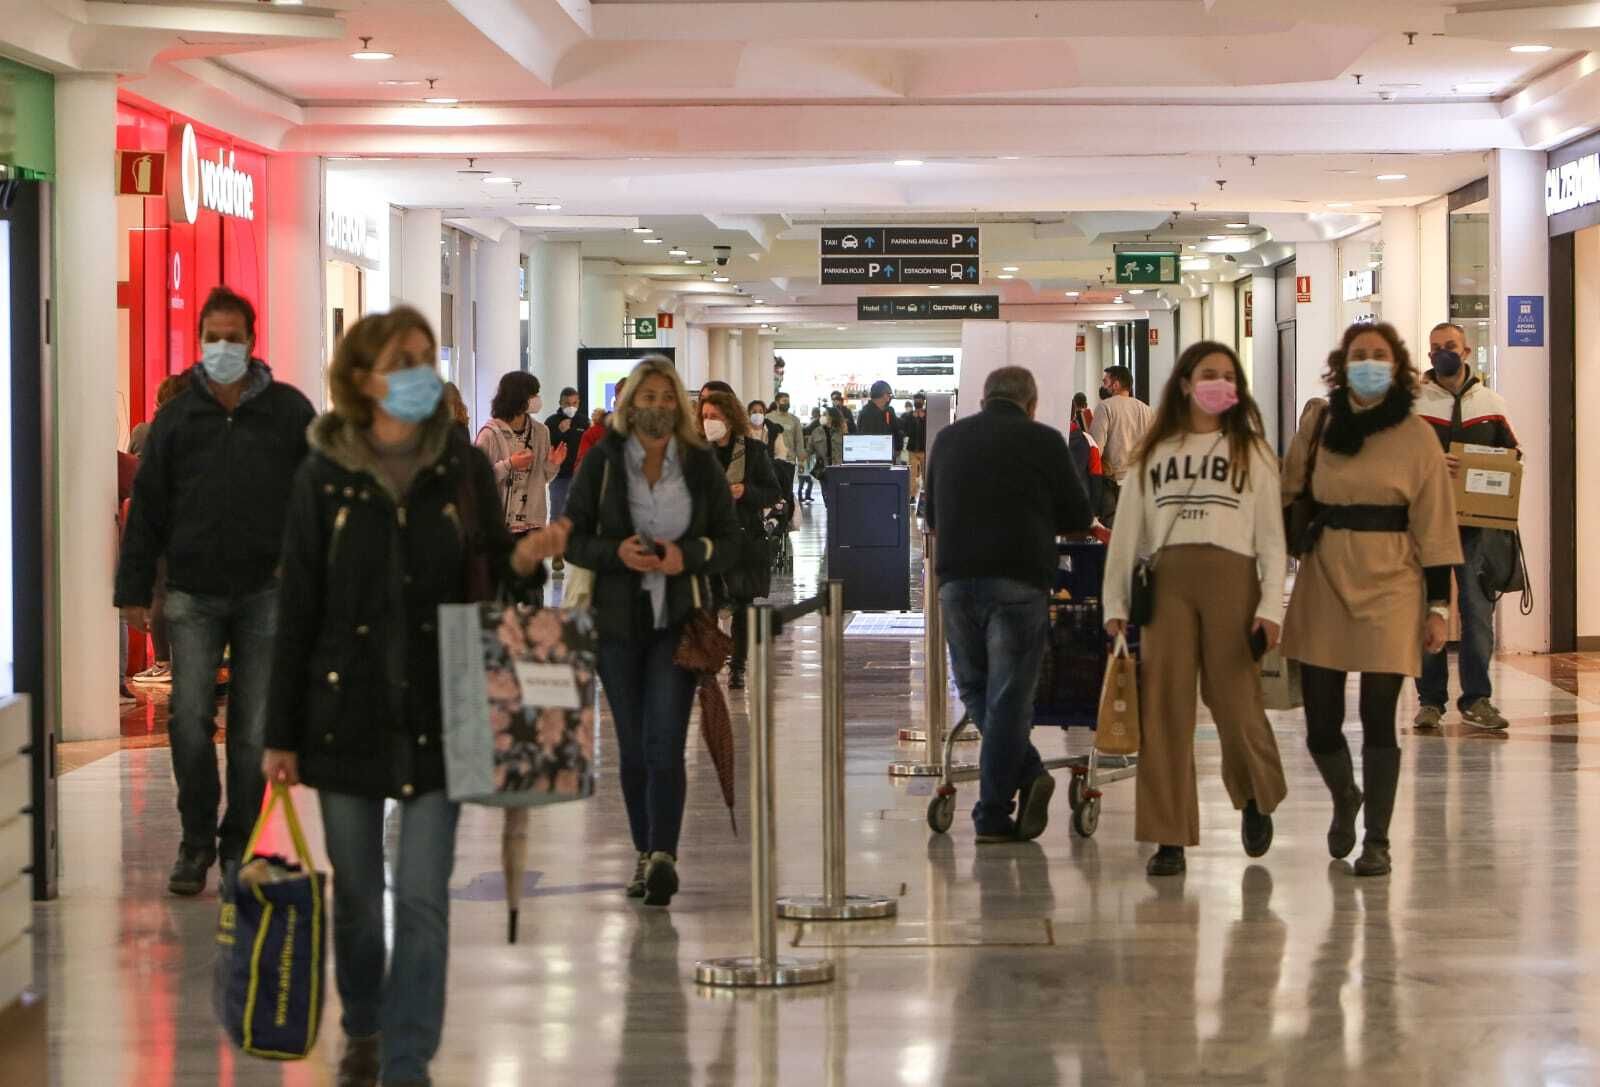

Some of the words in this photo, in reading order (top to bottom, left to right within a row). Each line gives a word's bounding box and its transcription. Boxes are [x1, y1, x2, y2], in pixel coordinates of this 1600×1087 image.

[200, 147, 254, 222] vodafone
[951, 233, 963, 248] P
[868, 263, 880, 278] P
[863, 304, 880, 312] Hotel
[932, 303, 967, 311] Carrefour
[1150, 454, 1248, 495] MALIBU
